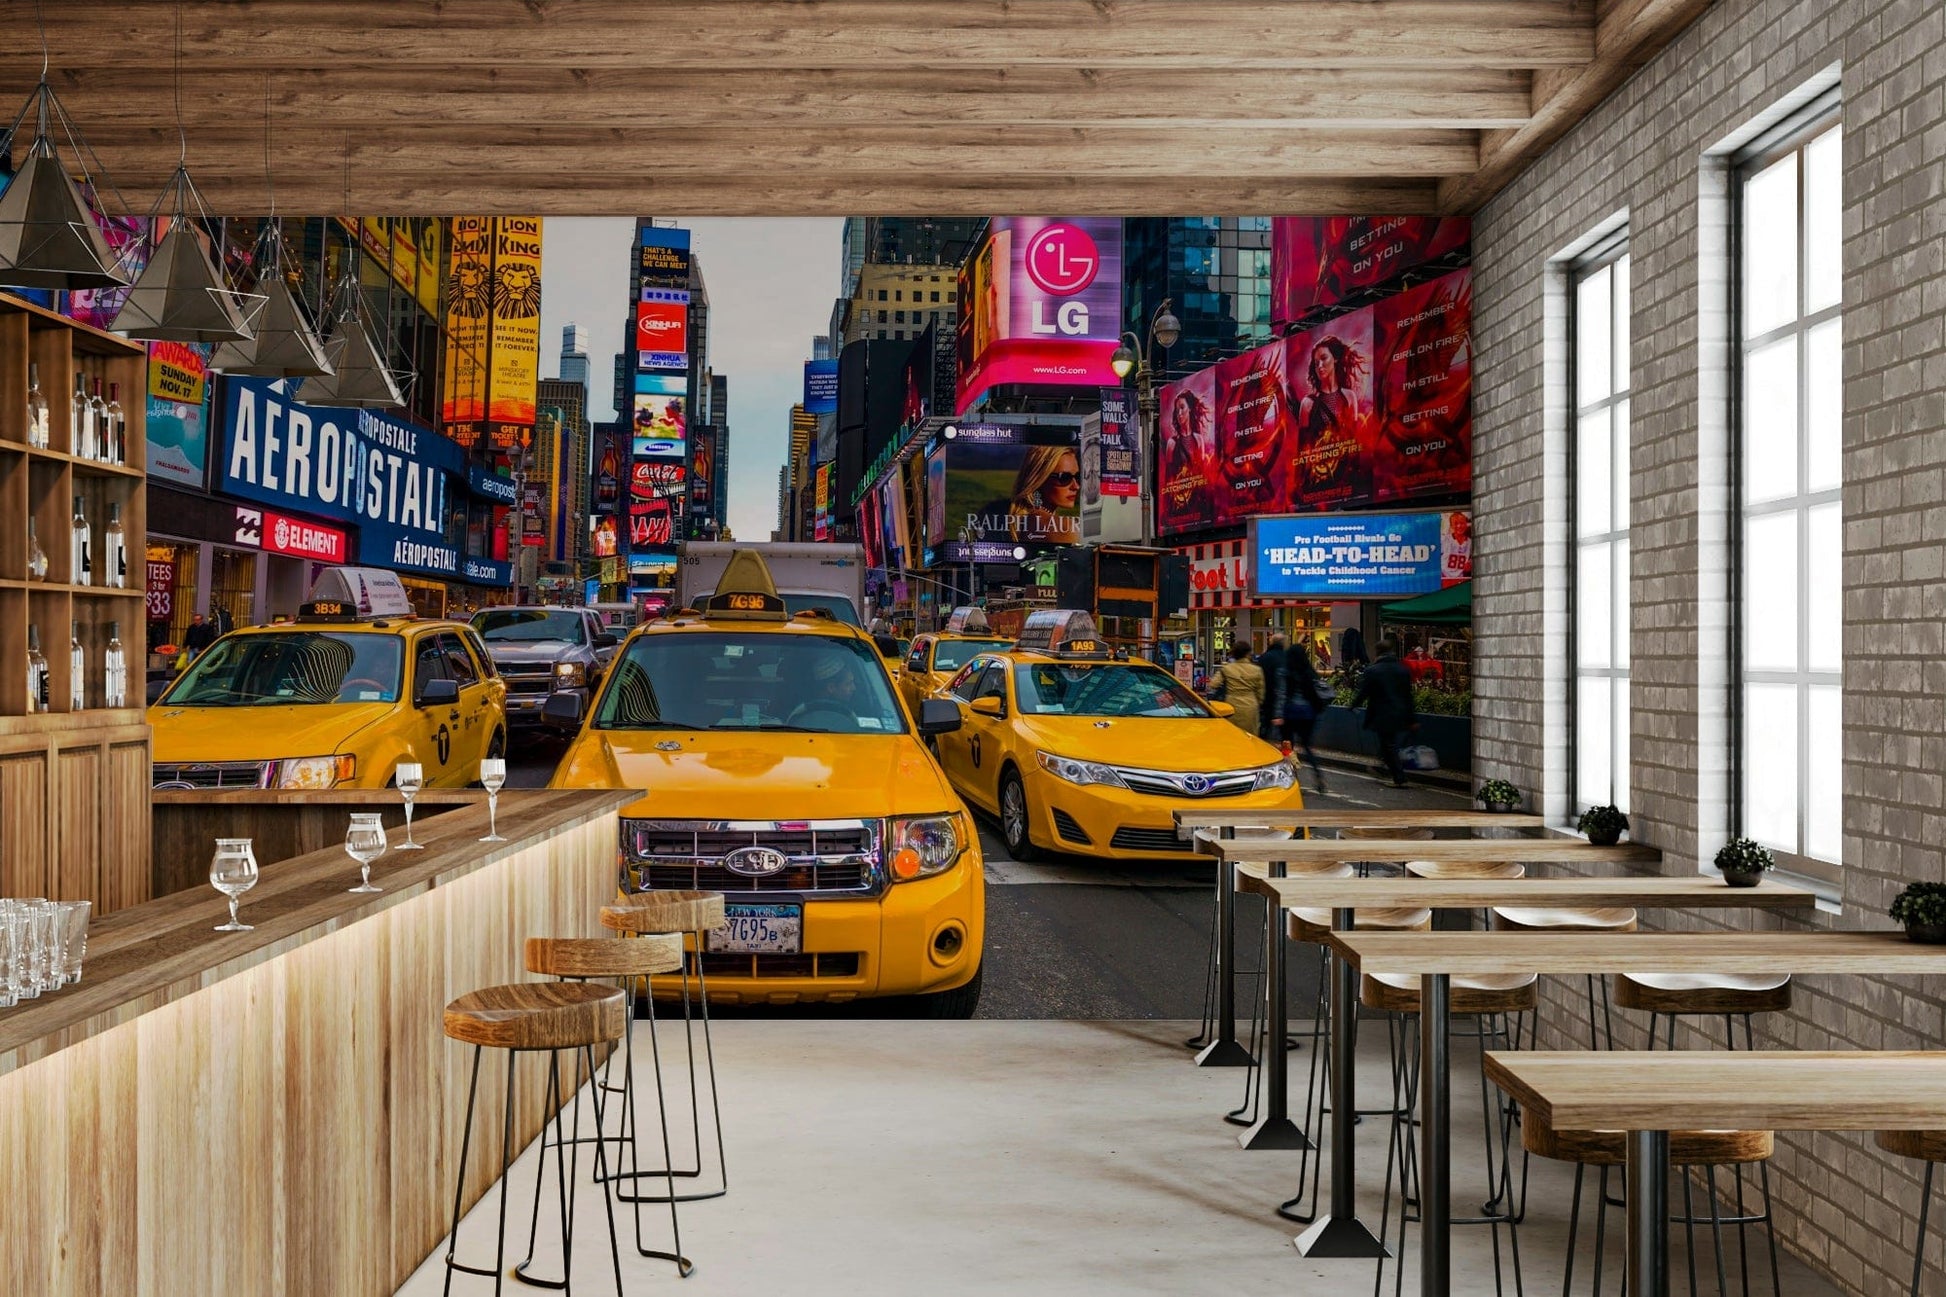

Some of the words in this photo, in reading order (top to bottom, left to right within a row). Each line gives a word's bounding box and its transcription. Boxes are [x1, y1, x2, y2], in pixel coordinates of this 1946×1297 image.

[502, 217, 537, 233] LION
[1350, 217, 1407, 251] BETTING
[499, 235, 540, 255] KING
[644, 247, 665, 255] THAT'S
[643, 254, 679, 262] CHALLENGE
[1353, 257, 1371, 274] ON
[1376, 241, 1403, 262] YOU
[1032, 301, 1090, 335] LG
[1396, 302, 1455, 329] REMEMBER
[496, 335, 534, 344] REMEMBER
[651, 353, 680, 362] XINHUA
[1393, 348, 1416, 362] GIRL
[1418, 342, 1433, 354] ON
[160, 364, 197, 387] SUNDAY
[1033, 366, 1087, 375] www.LG.com
[1230, 369, 1268, 388] REMEMBER
[1403, 378, 1417, 391] I'M
[1418, 372, 1449, 388] STILL
[160, 379, 182, 395] NOV.
[183, 386, 191, 398] 17
[1102, 401, 1125, 413] SOME
[1244, 400, 1254, 408] ON
[1102, 412, 1128, 424] WALLS
[1403, 405, 1449, 423] BETTING
[501, 425, 520, 434] GET
[958, 428, 996, 438] sunglass
[997, 428, 1012, 438] hut
[1244, 425, 1264, 436] STILL
[1102, 434, 1121, 445] TALK
[1292, 448, 1339, 466] CATCHING
[1342, 443, 1363, 455] FIRE
[1406, 444, 1421, 455] ON
[1423, 440, 1446, 453] YOU
[1234, 451, 1264, 464] BETTING
[1162, 482, 1192, 495] CATCHING
[1235, 481, 1246, 490] ON
[1246, 478, 1262, 488] YOU
[967, 513, 1028, 533] RALPH
[290, 524, 338, 556] ELEMENT
[1294, 535, 1310, 544] Pro
[1313, 534, 1352, 544] Football
[1354, 534, 1386, 542] Rivals
[394, 536, 456, 572] AÉROPOSTALE
[683, 556, 700, 566] 505
[1448, 554, 1467, 570] 88
[147, 563, 172, 581] TEES
[1282, 567, 1292, 576] to
[1293, 566, 1326, 576] Tackle
[1328, 566, 1378, 575] Childhood
[1380, 566, 1416, 575] Cancer
[152, 581, 157, 590] 3
[158, 581, 166, 590] for
[146, 591, 170, 615] $33
[314, 602, 342, 615] 3B34
[729, 594, 765, 609] 7G95
[1070, 640, 1095, 651] 1A93
